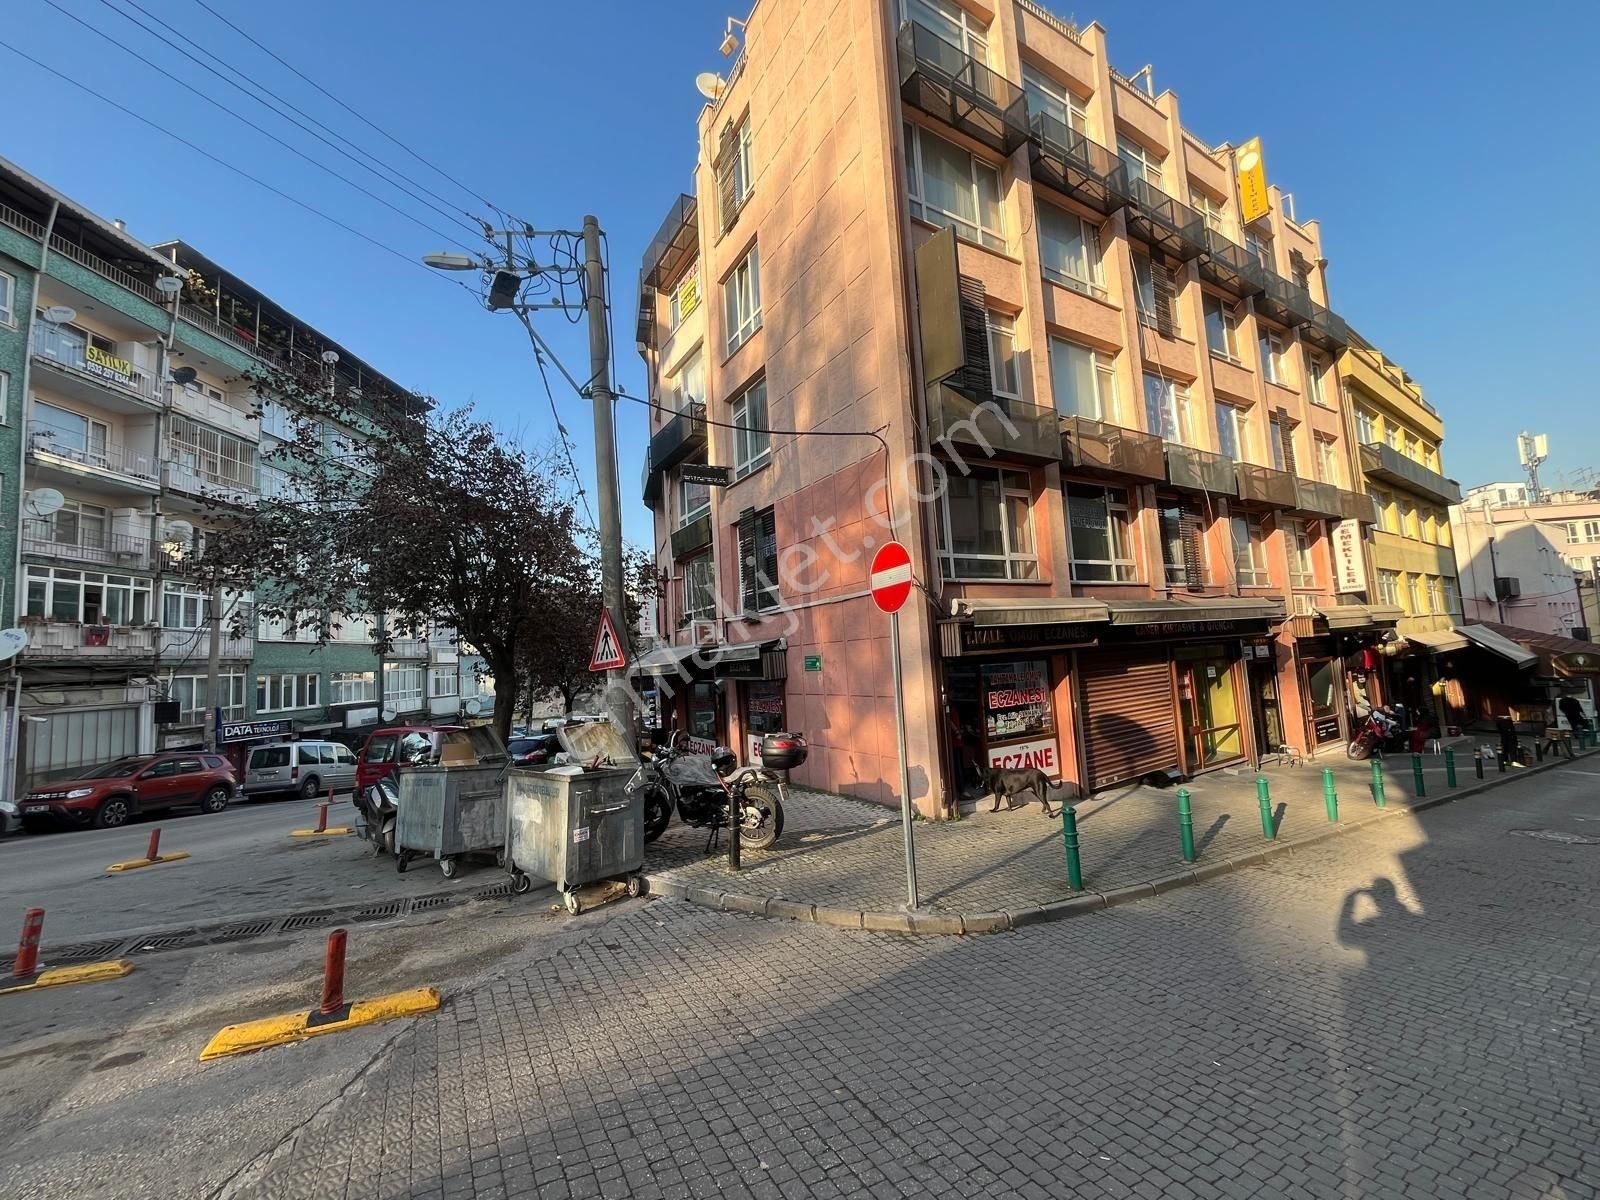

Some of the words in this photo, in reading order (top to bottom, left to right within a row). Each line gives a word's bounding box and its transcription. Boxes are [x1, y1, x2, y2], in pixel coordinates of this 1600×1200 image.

[88, 347, 129, 374] SATILIK
[225, 725, 253, 737] DATA
[992, 748, 1054, 769] ECZANE
